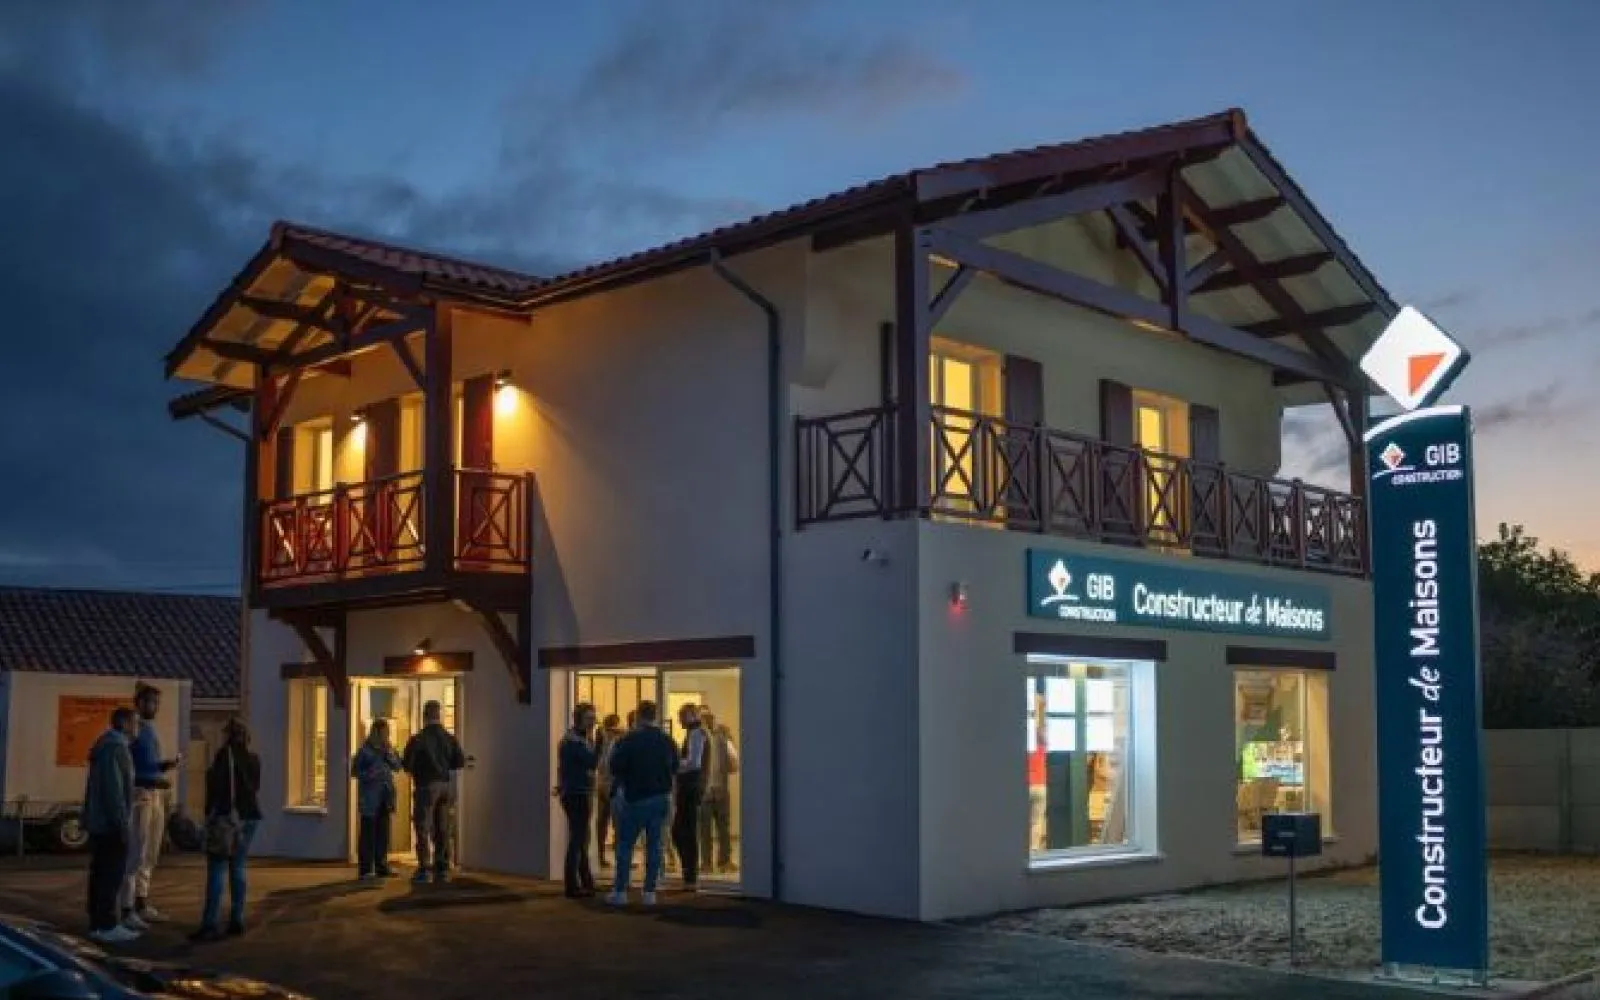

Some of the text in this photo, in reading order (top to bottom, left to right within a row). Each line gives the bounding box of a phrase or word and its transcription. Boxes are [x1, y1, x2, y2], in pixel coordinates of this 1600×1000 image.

[1426, 443, 1461, 466] GIB
[1086, 573, 1114, 600] GIB
[1133, 583, 1323, 632] Constructeur de Maisons
[1409, 519, 1447, 929] Constructeur de Maisons
